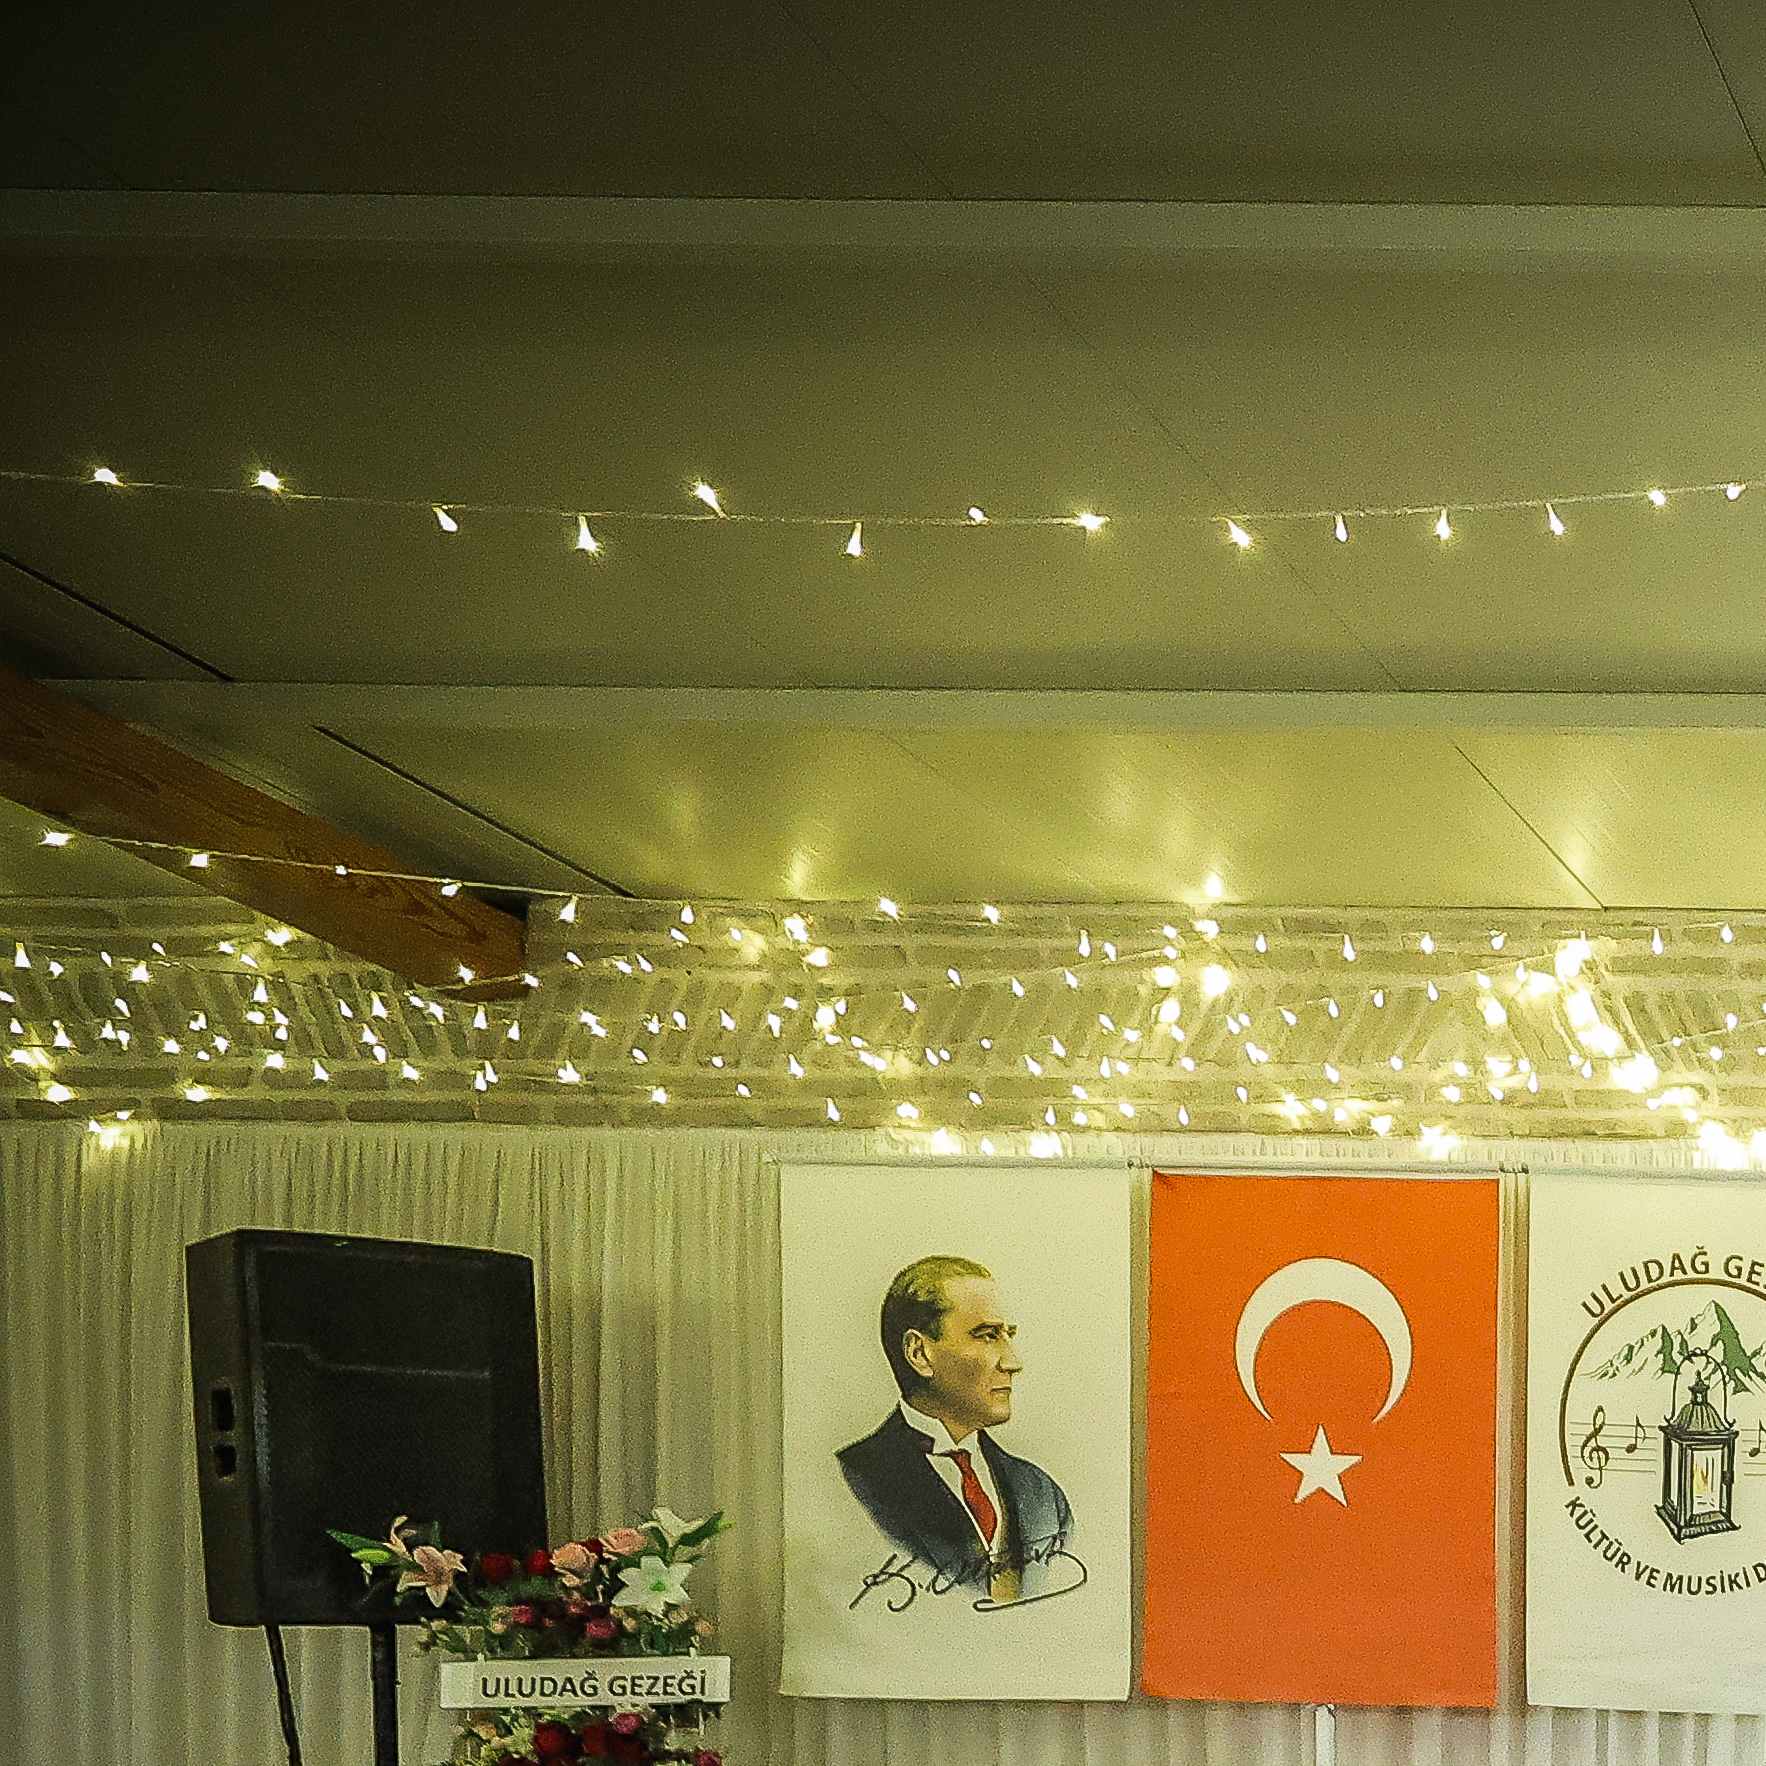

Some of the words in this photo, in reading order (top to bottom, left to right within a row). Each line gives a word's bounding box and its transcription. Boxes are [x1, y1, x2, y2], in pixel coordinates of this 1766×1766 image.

[1580, 1245, 1711, 1319] ULUDAĞ
[1564, 1495, 1632, 1574] KÜLTÜR
[1633, 1560, 1661, 1589] VE
[1662, 1566, 1752, 1596] MUSİKİ
[481, 1669, 599, 1700] ULUDAĞ
[608, 1668, 707, 1698] GEZEĞİ
